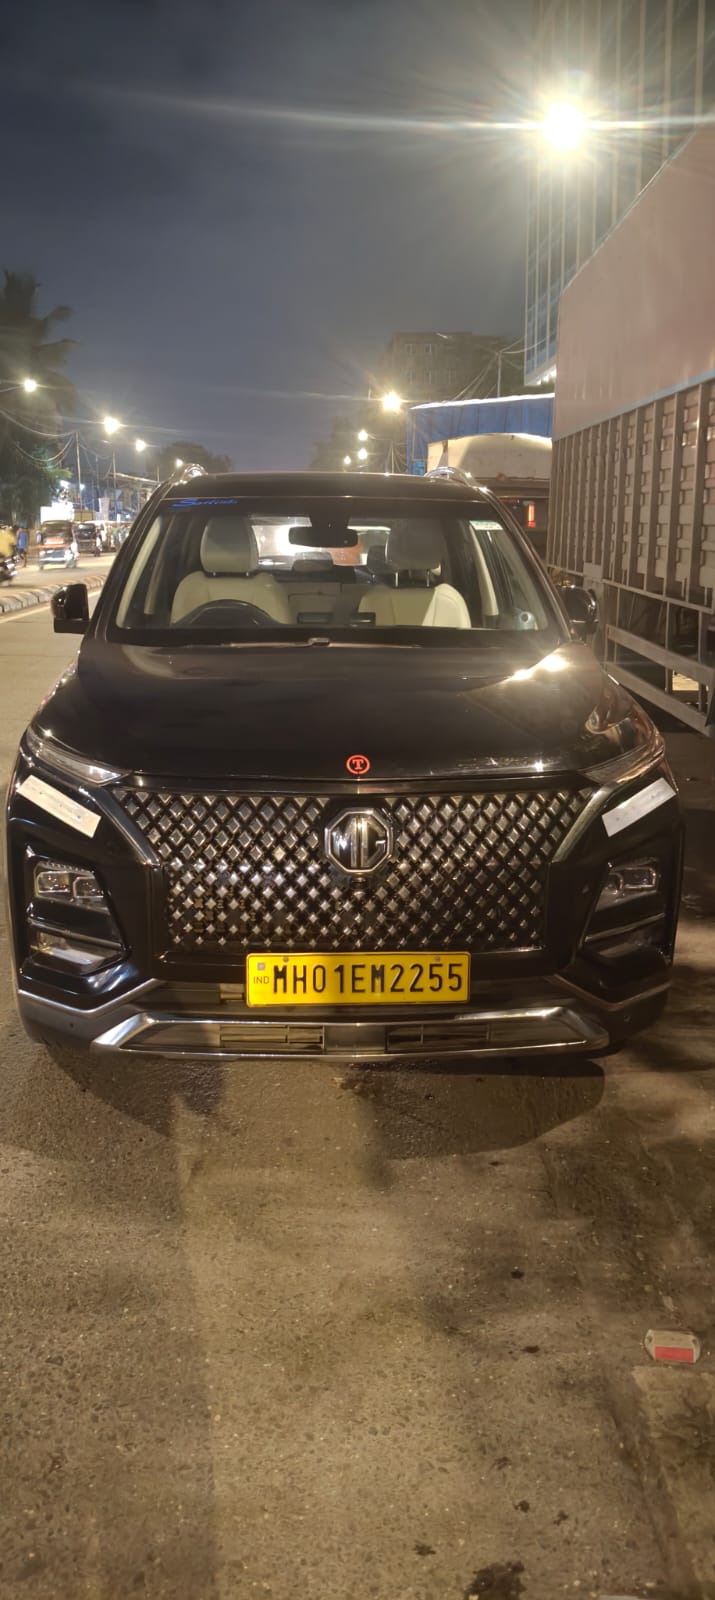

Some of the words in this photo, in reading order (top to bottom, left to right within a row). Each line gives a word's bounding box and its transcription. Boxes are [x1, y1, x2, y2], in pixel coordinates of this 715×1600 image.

[331, 816, 387, 868] MG
[252, 975, 270, 985] IND
[273, 963, 462, 994] MH01EM2255
